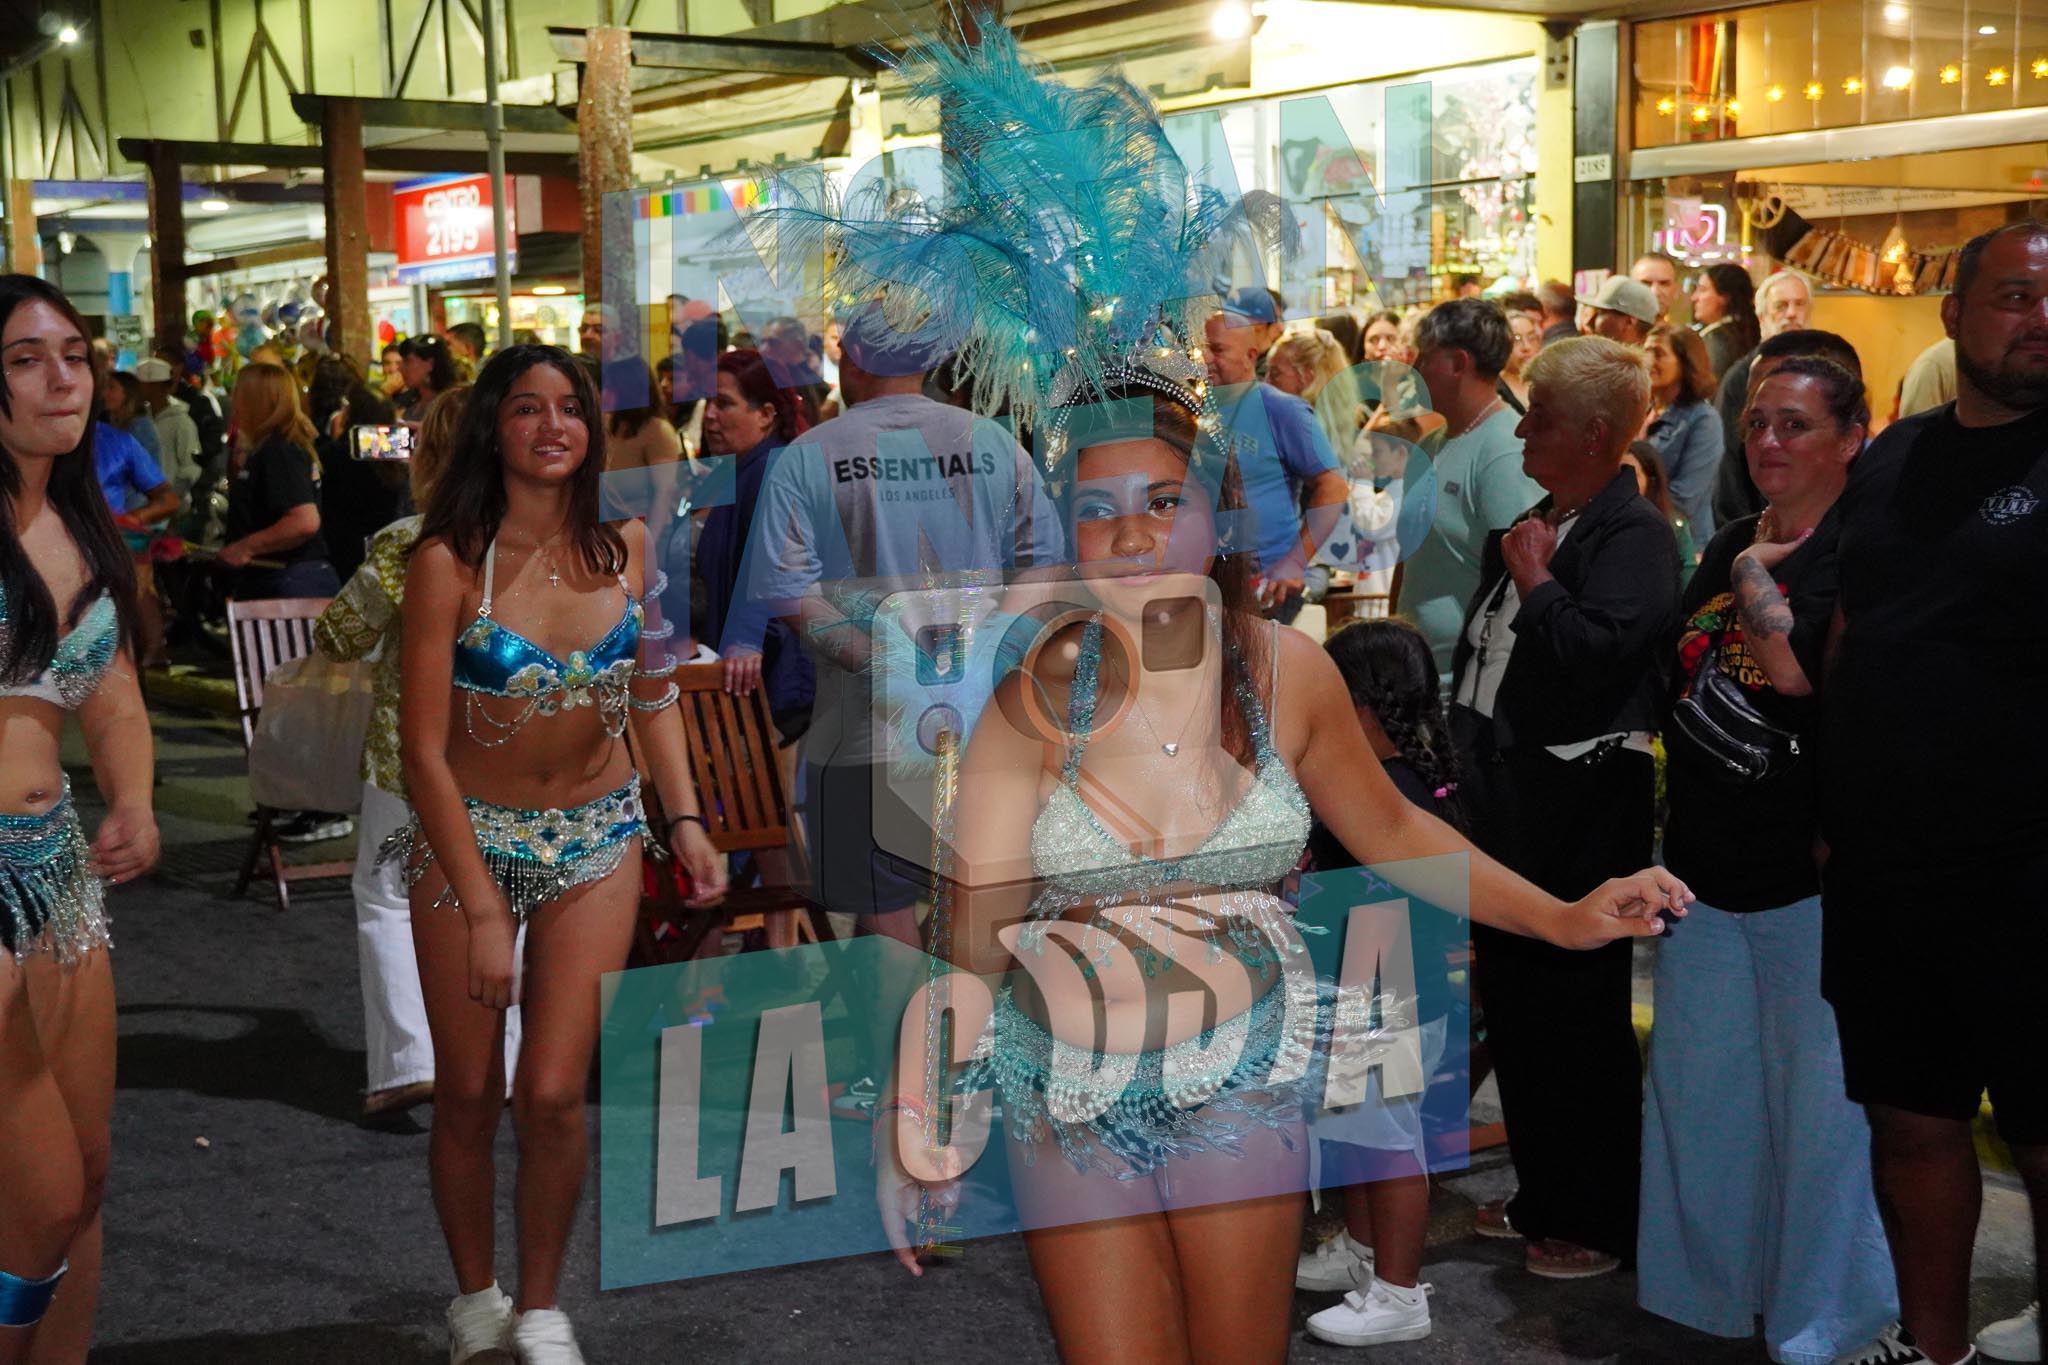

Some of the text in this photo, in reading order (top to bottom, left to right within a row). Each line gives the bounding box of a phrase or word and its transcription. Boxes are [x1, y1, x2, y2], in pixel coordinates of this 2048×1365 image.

[834, 452, 995, 483] ESSENTIALS
[880, 487, 955, 502] LOS ANGELES
